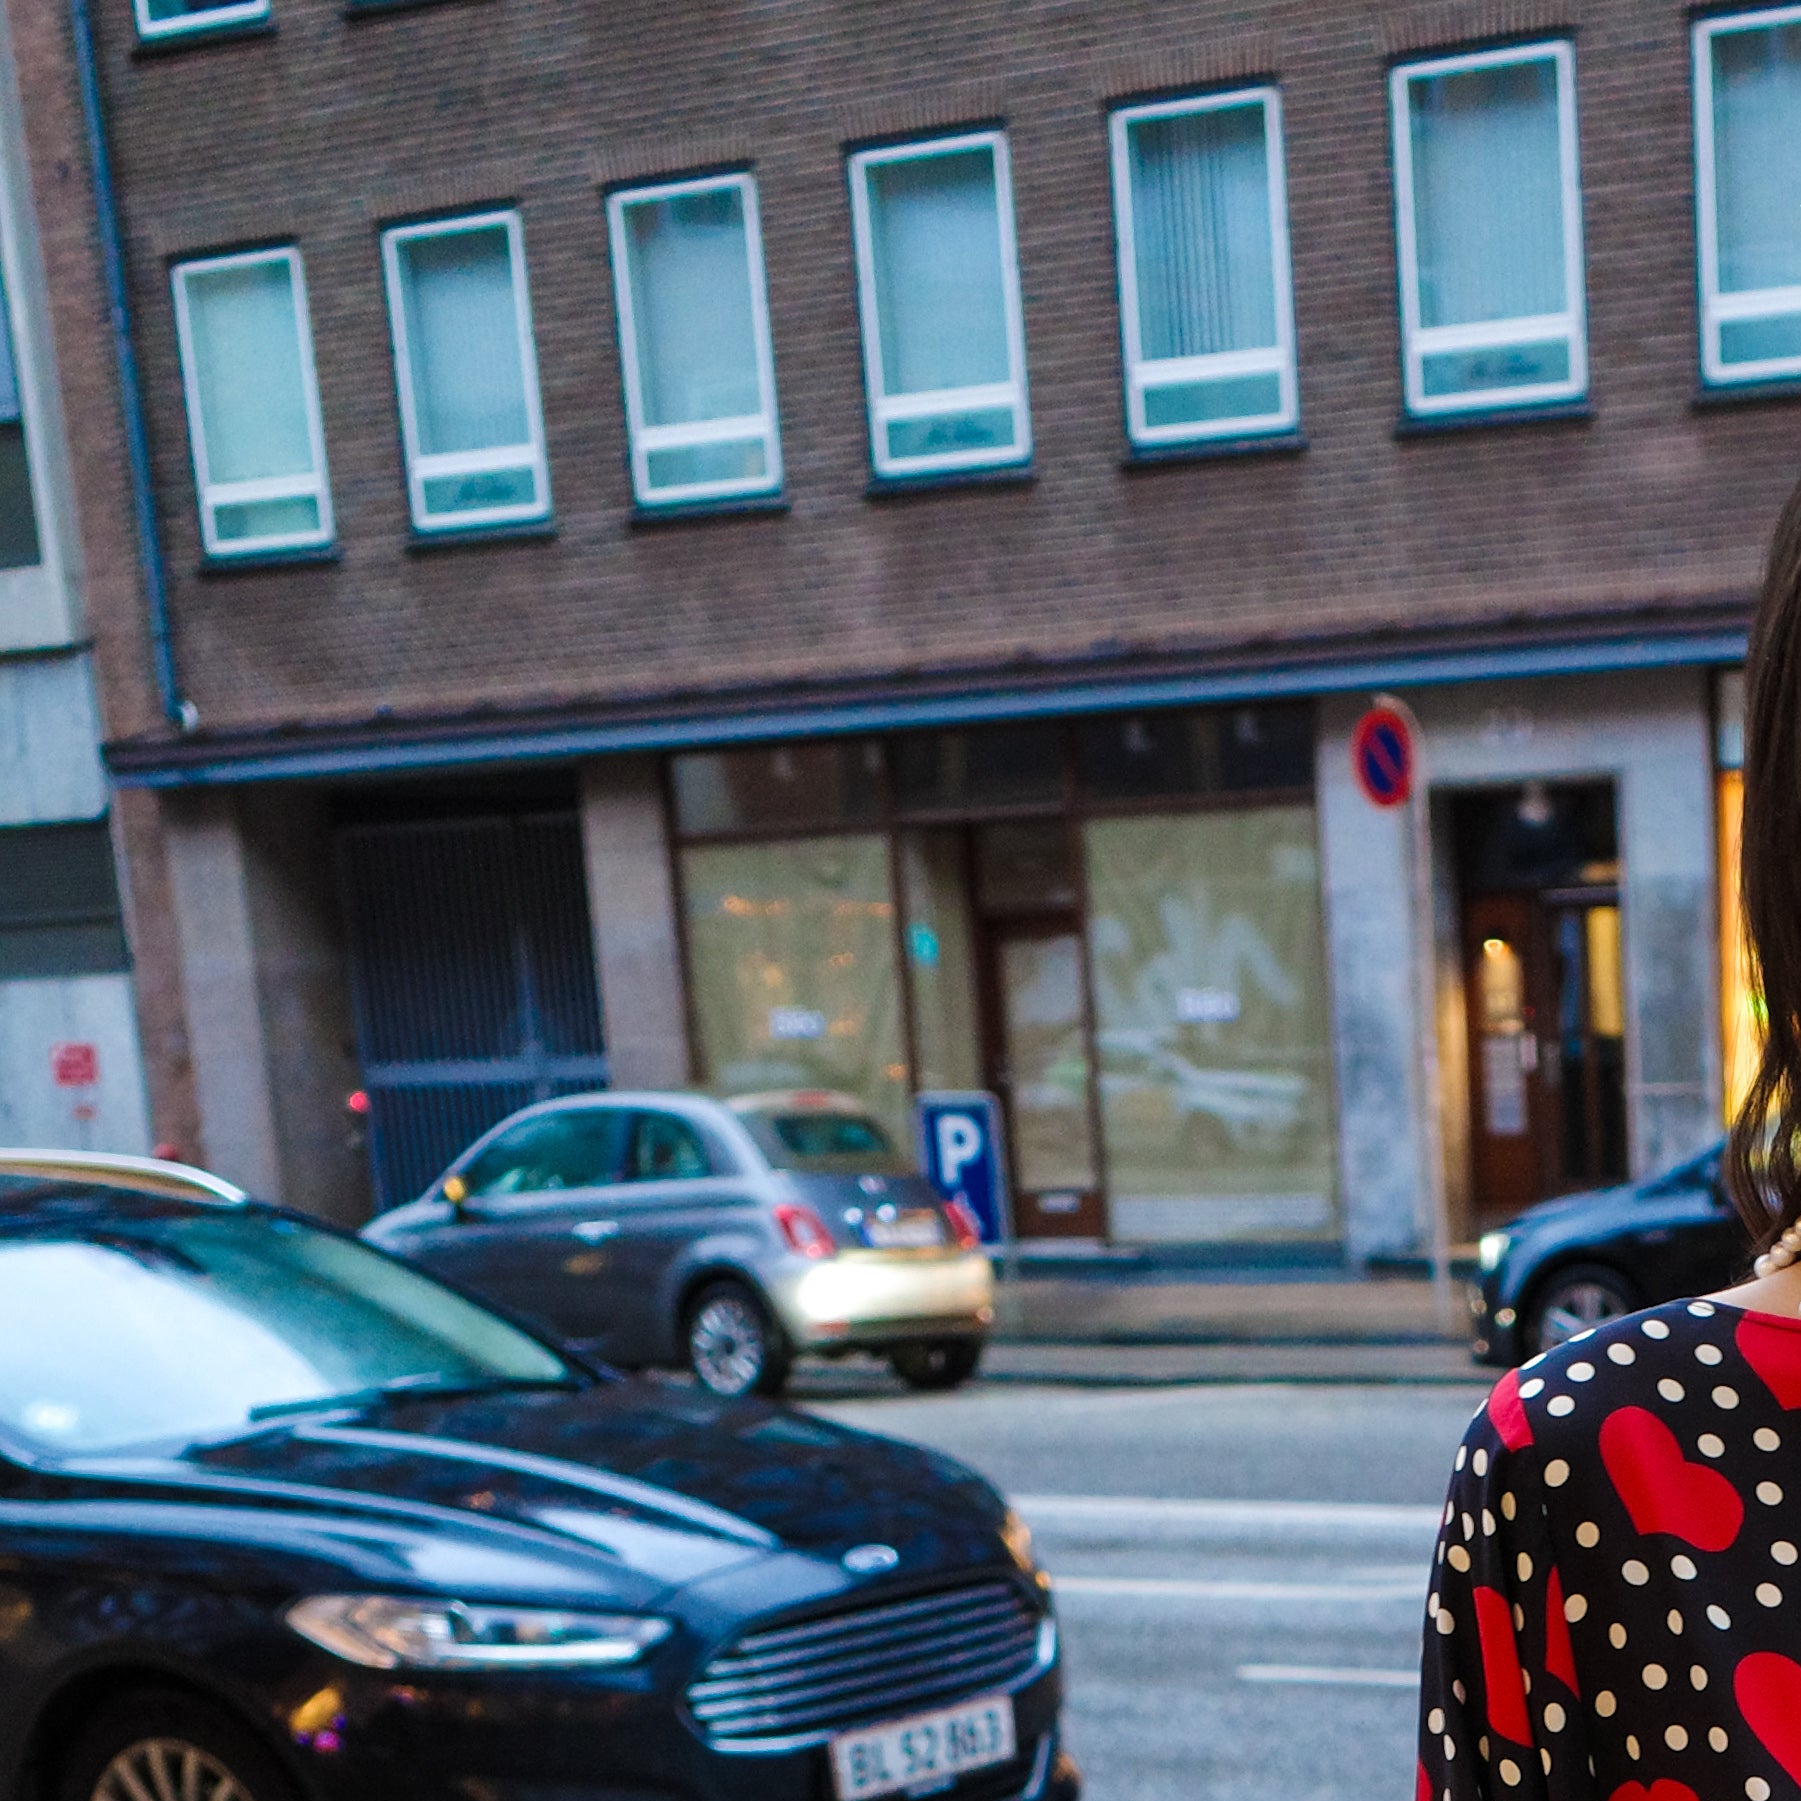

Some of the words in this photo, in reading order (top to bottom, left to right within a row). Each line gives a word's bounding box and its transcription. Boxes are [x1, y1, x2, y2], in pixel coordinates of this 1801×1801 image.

[936, 1114, 983, 1184] P
[852, 1743, 893, 1788] BL
[901, 1727, 938, 1775] 52
